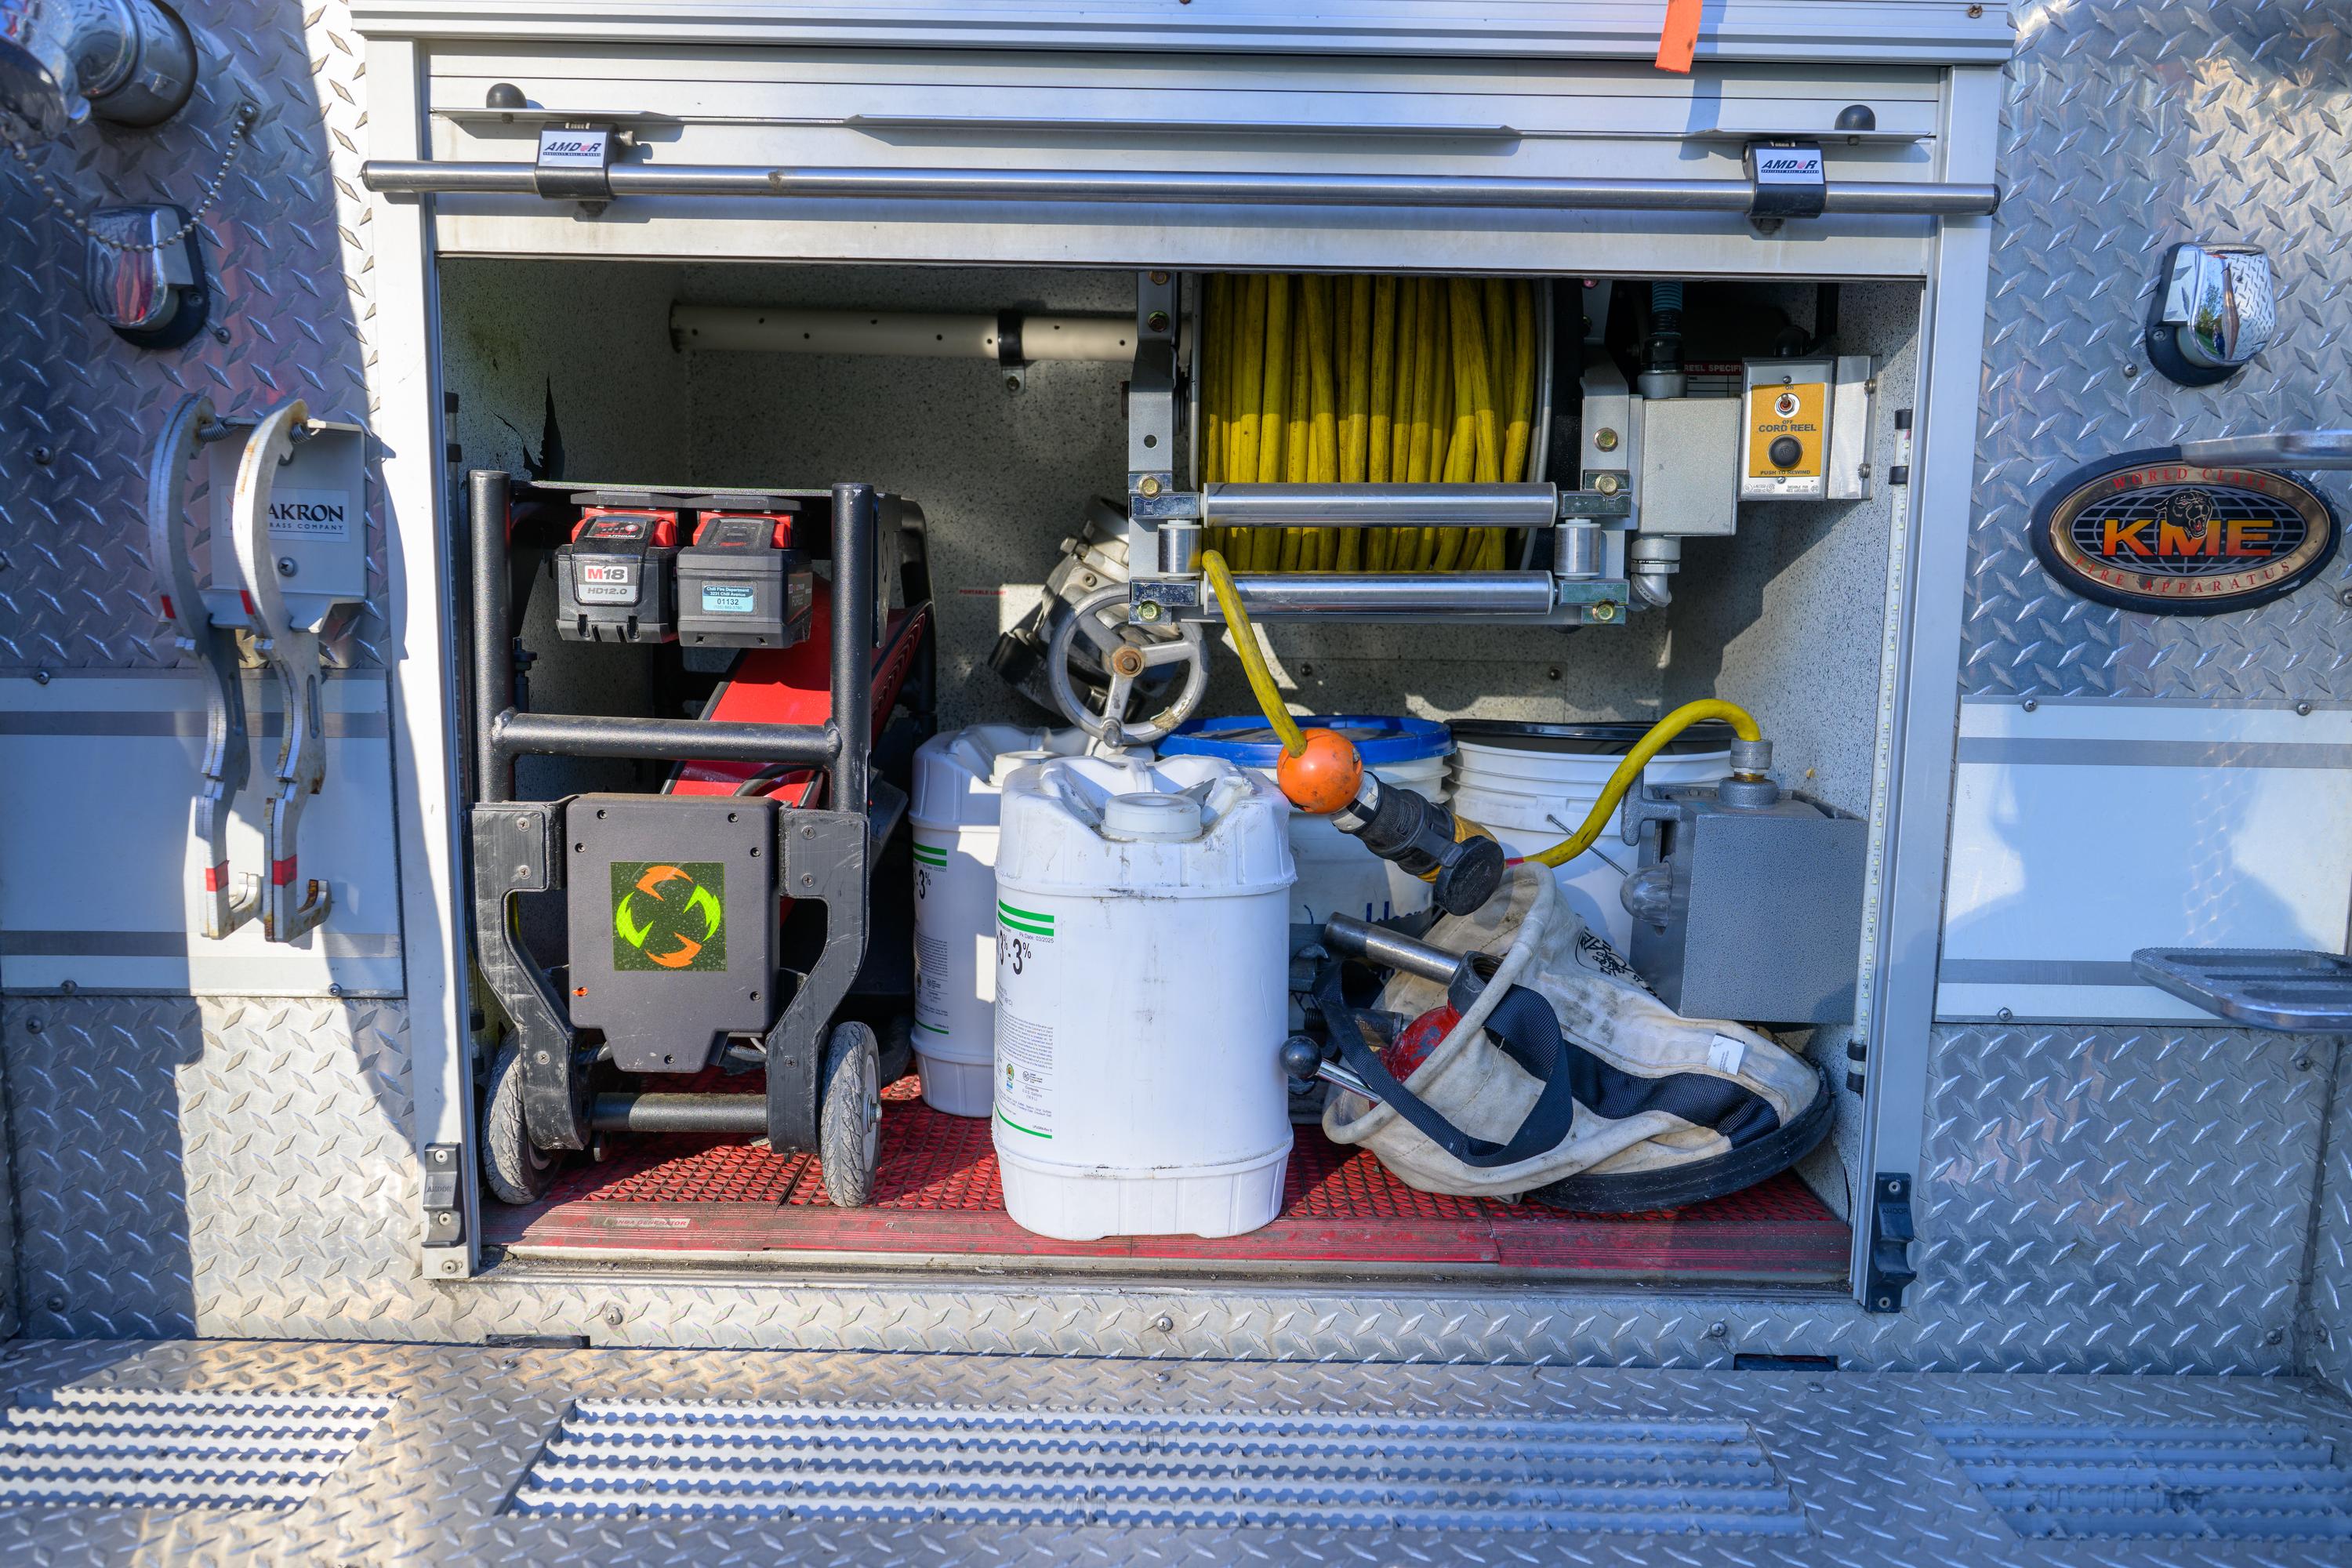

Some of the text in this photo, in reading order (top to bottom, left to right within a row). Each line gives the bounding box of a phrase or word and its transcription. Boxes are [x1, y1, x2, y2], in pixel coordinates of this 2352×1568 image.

[1759, 423, 1817, 433] CORD REEL
[2112, 466, 2267, 490] WORLD CLASS
[268, 503, 344, 522] AKRON
[2102, 519, 2274, 557] KME
[588, 568, 625, 580] M18
[2074, 554, 2290, 593] FIRE APPARATUS
